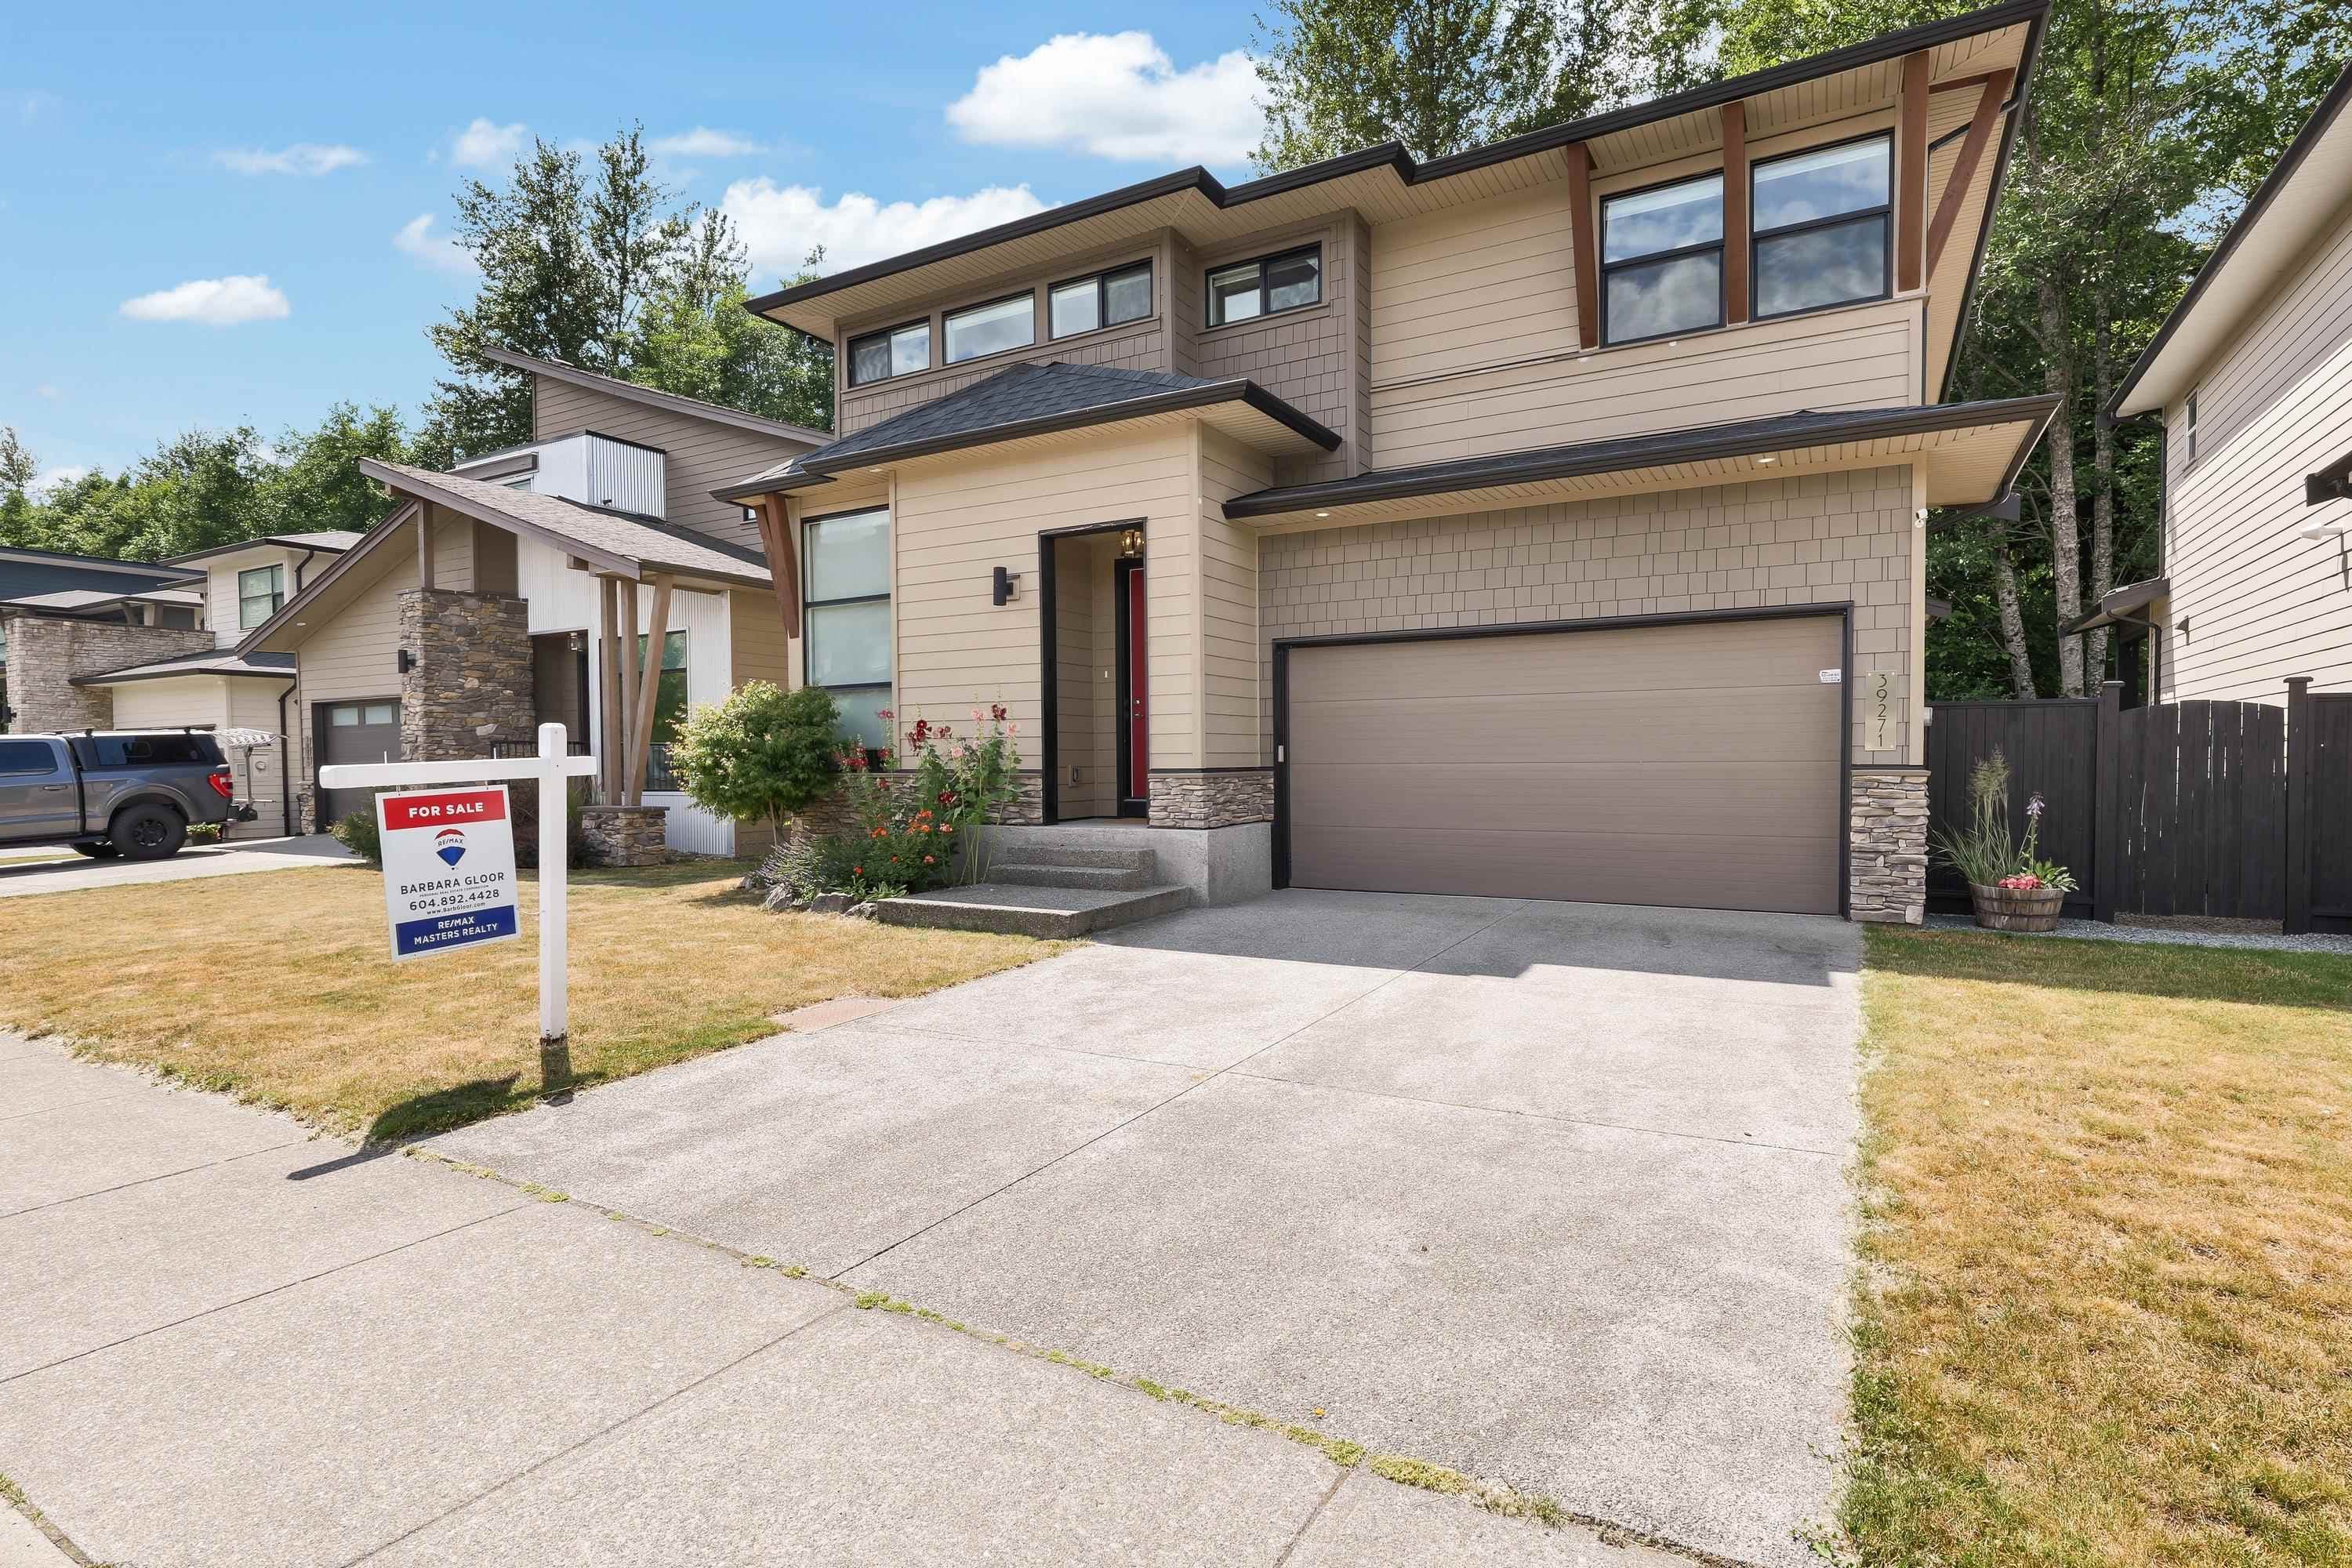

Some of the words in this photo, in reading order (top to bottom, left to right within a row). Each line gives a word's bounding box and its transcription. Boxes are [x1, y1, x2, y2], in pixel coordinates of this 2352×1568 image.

[1876, 674, 1888, 747] 39271
[408, 806, 441, 818] FOR
[446, 802, 484, 815] SALE
[437, 838, 464, 848] RE/MAX
[401, 878, 460, 895] BARBARA
[464, 872, 504, 885] GLOOR
[409, 889, 499, 910] 604.892.4428
[426, 902, 485, 915] www.BarbGloor.com
[437, 916, 475, 929] RE/MAX
[414, 930, 459, 945] MASTERS
[463, 923, 498, 937] REALTY
